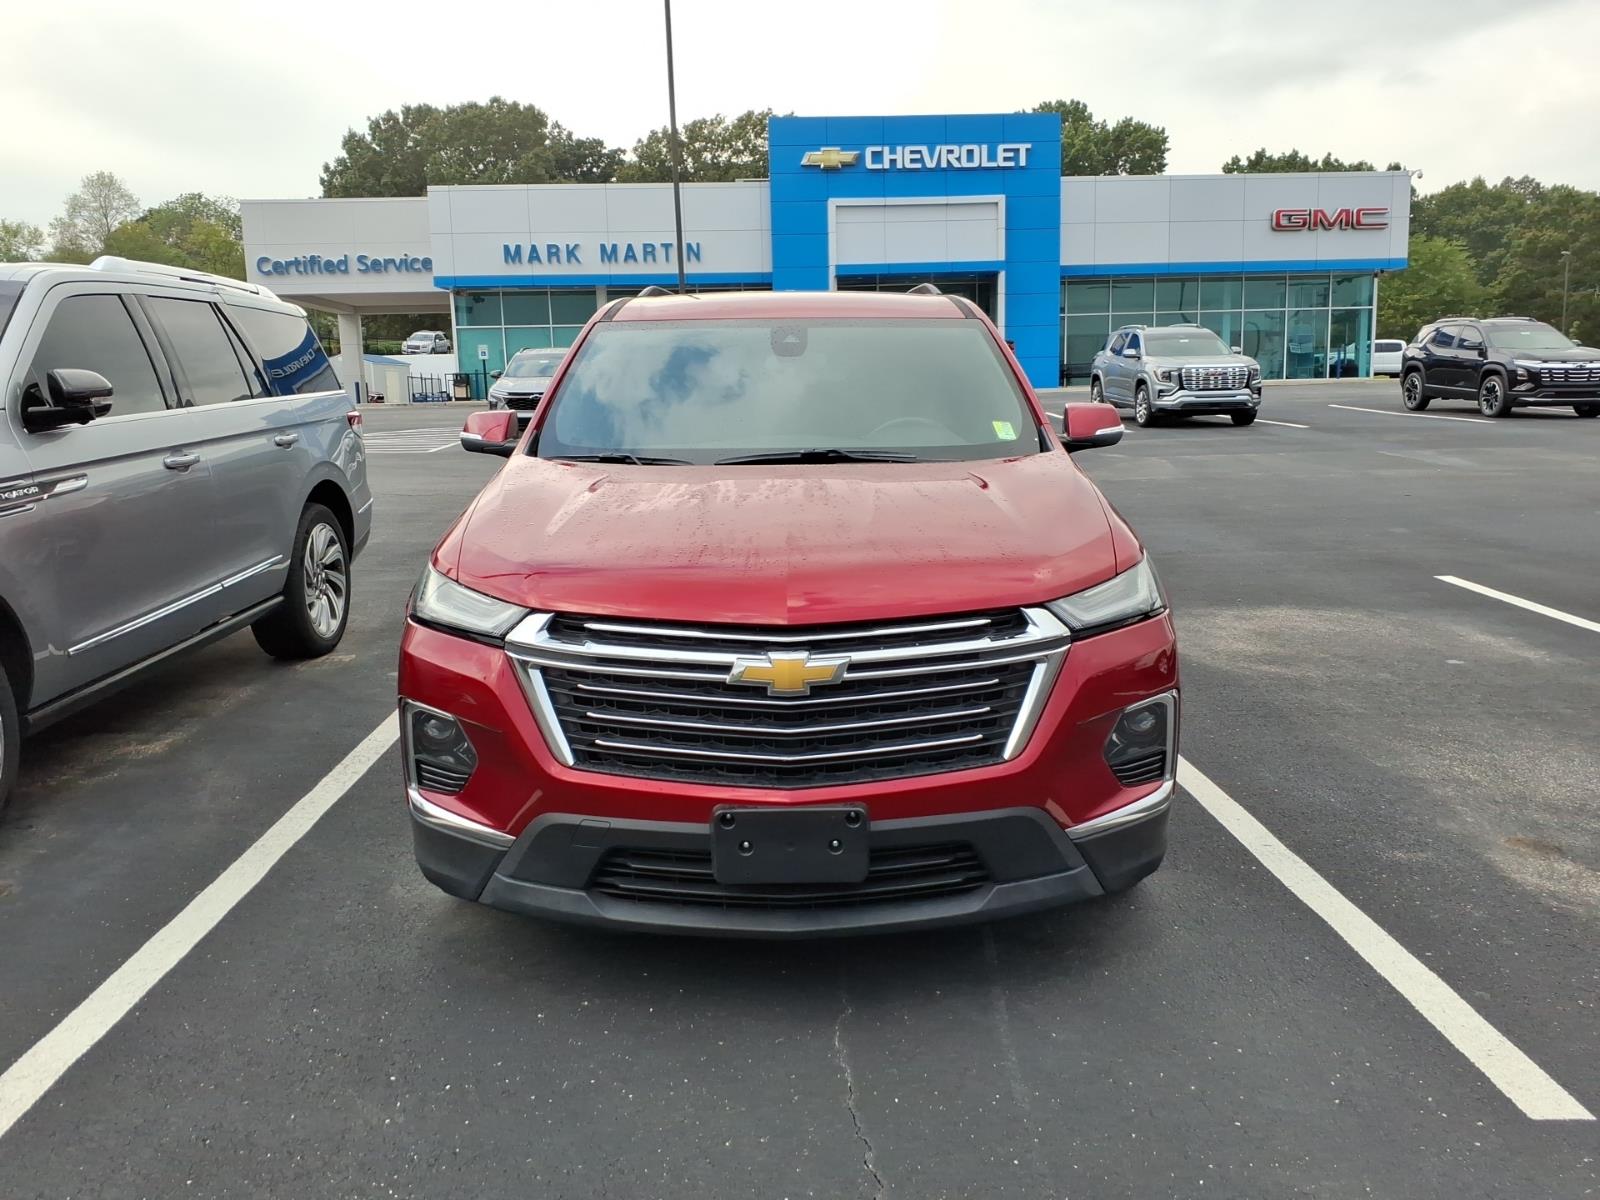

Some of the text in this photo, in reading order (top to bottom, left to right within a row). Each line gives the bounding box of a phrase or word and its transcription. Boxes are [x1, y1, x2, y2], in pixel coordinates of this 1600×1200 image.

[865, 143, 1032, 170] CHEVROLET
[1272, 208, 1389, 231] GMC
[503, 242, 701, 264] MARK MARTN
[256, 254, 432, 276] Certified Service
